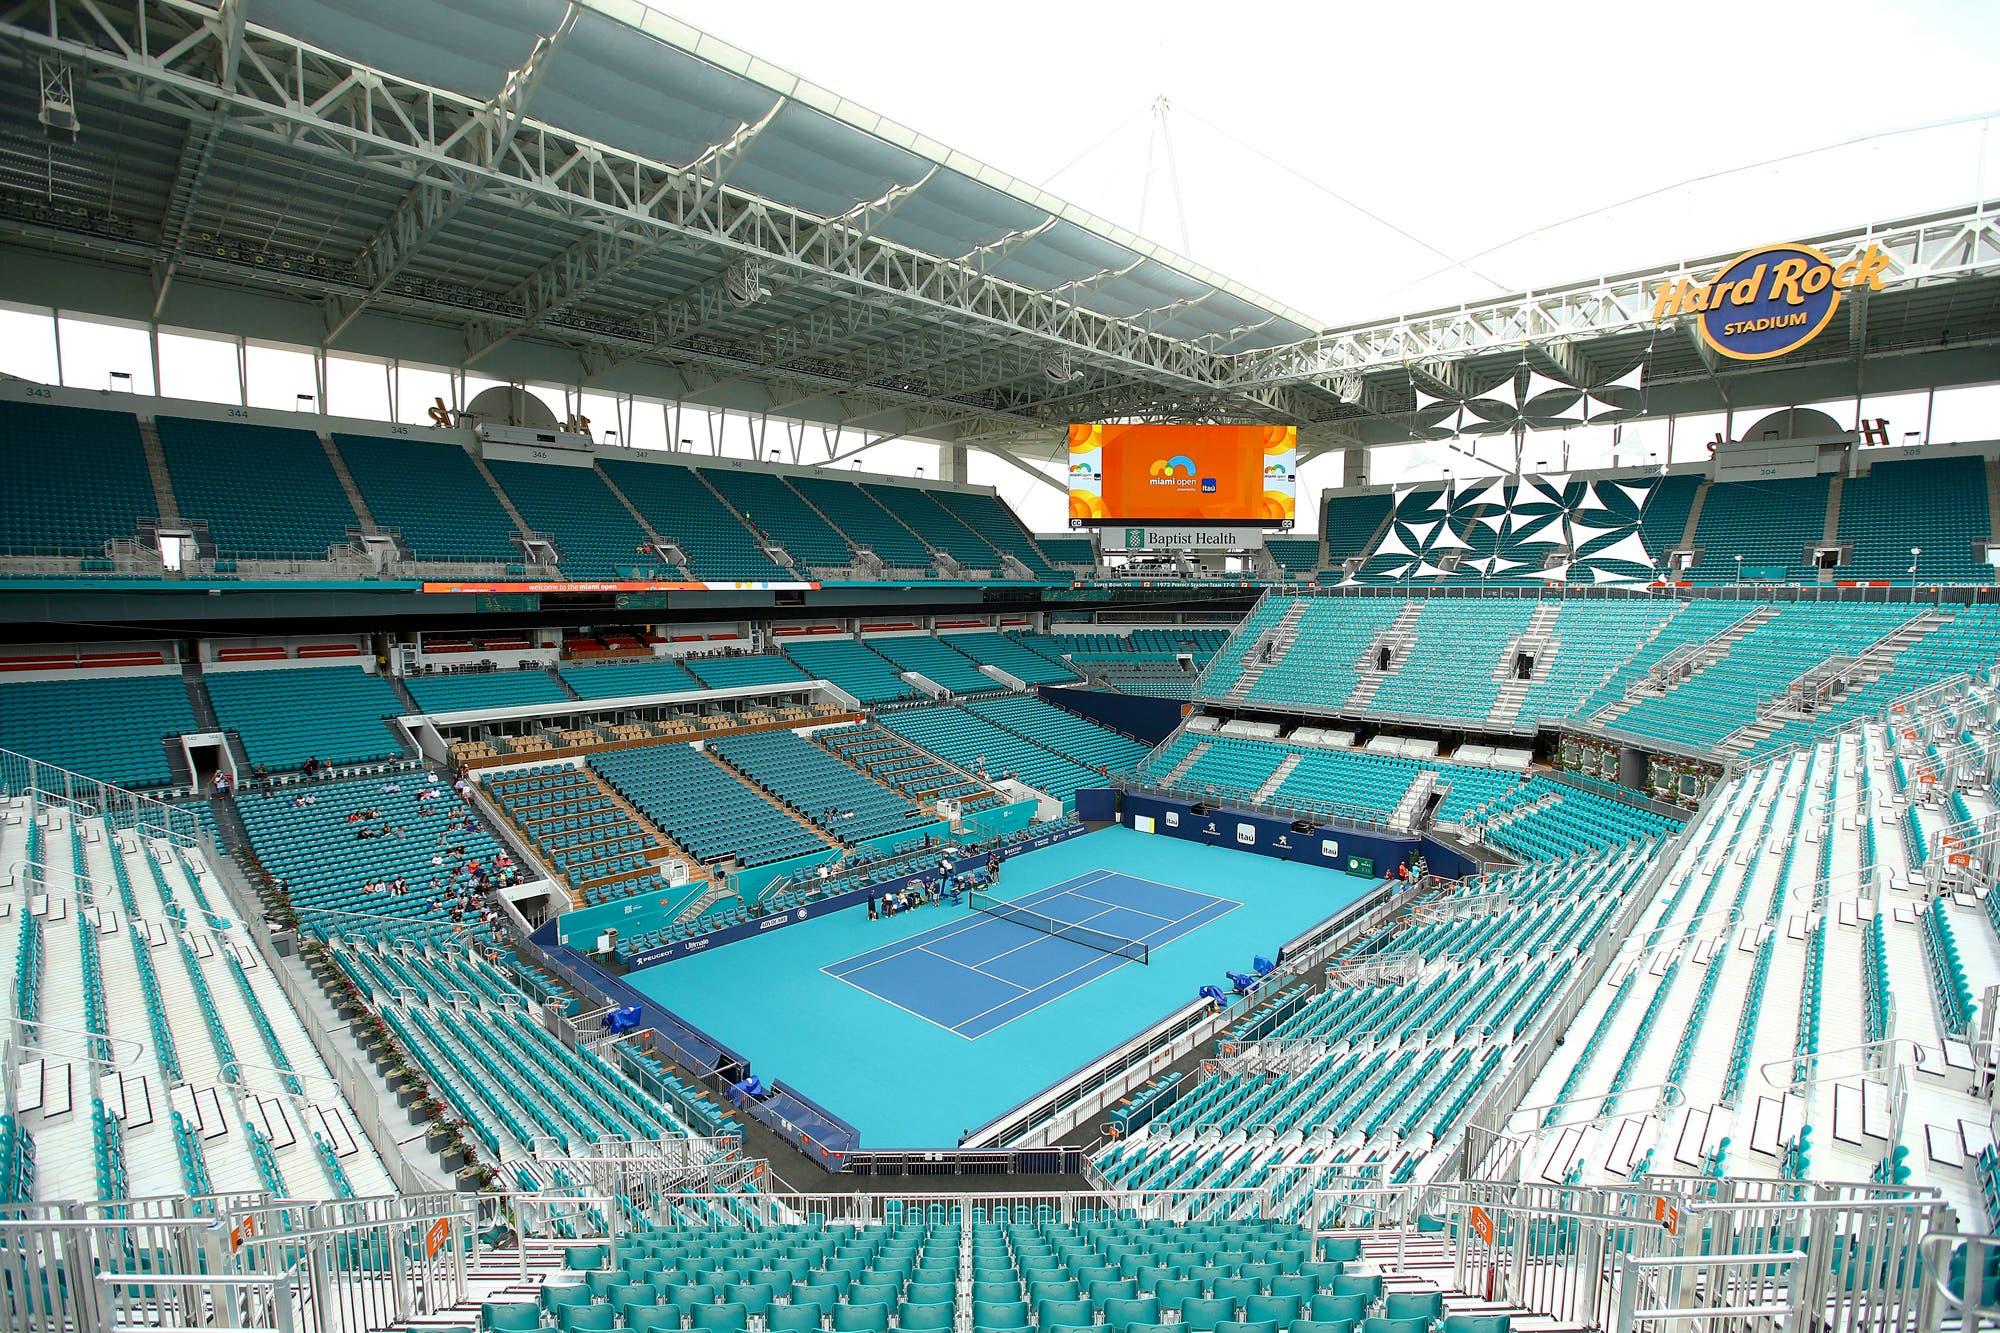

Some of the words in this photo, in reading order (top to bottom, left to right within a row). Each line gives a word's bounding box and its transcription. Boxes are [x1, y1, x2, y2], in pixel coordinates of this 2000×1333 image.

[1652, 263, 1767, 319] Hard
[1769, 243, 1890, 306] Rock
[1724, 312, 1808, 336] STADIUM
[26, 387, 51, 398] 343
[228, 408, 248, 418] 344
[391, 426, 408, 435] 345
[532, 451, 547, 459] 346
[1760, 468, 1776, 476] 304
[1149, 477, 1175, 485] miami
[1176, 479, 1196, 487] open
[1149, 531, 1192, 547] Baptist
[1196, 532, 1236, 545] Health
[529, 583, 558, 591] welcome
[567, 583, 579, 591] the
[1166, 818, 1178, 826] Itaú
[1238, 832, 1254, 842] Itaú
[1323, 847, 1337, 855] Itaú
[761, 916, 788, 928] ADVOCARE
[684, 938, 709, 950] Ultimate
[642, 950, 674, 963] PEUGEOT
